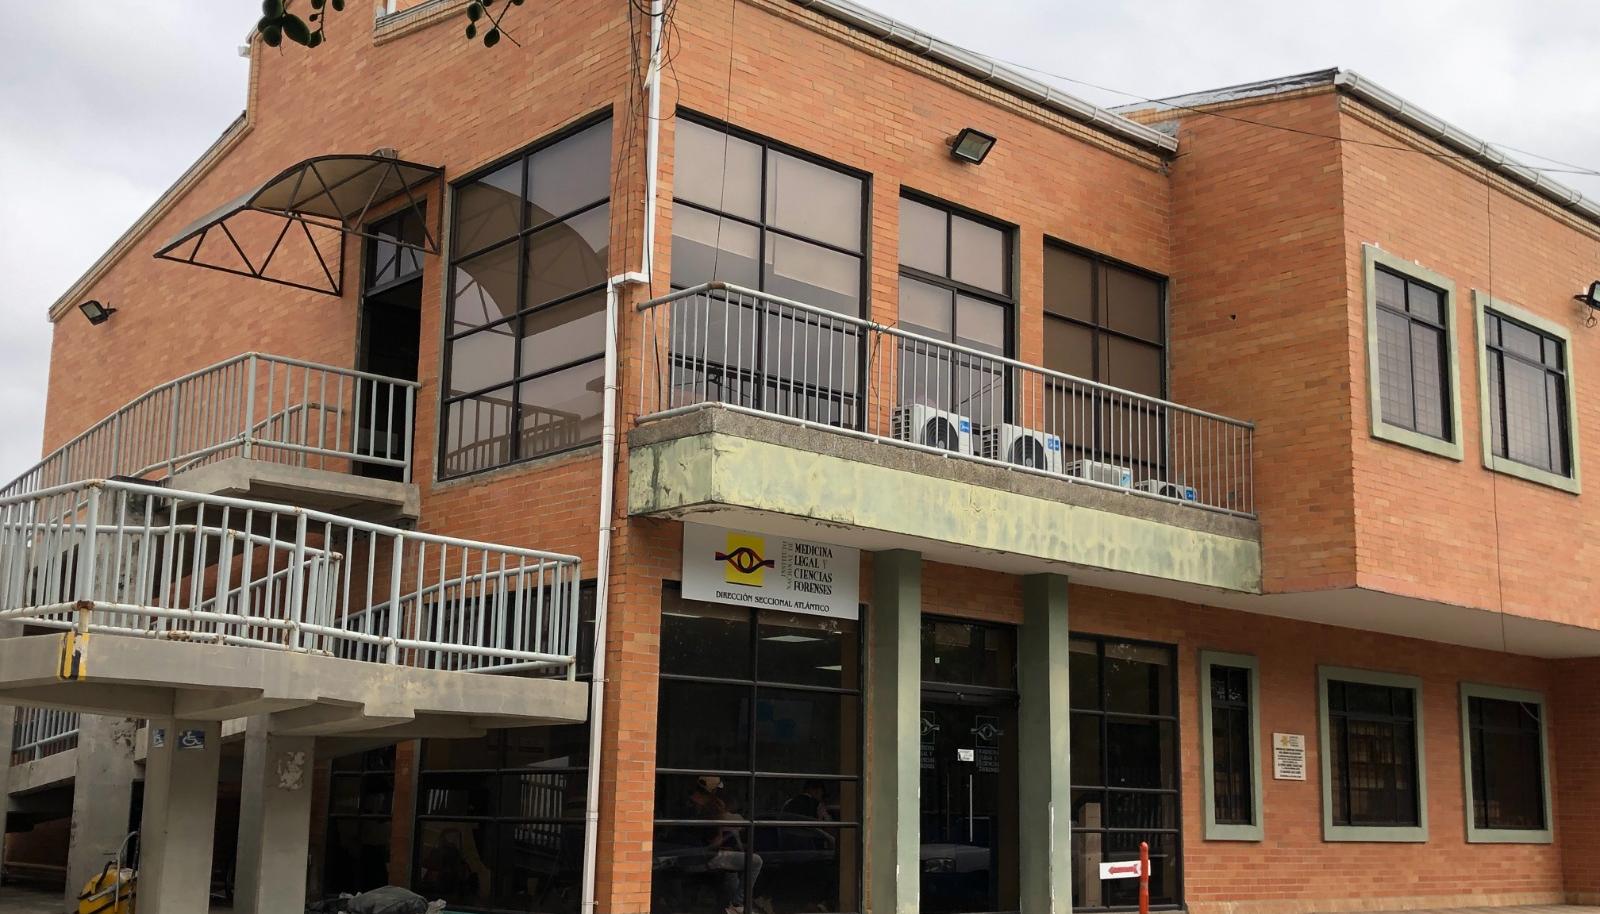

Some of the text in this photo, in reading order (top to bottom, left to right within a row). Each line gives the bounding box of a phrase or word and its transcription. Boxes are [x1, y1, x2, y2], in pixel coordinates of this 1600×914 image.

[794, 542, 832, 558] MEDICINA
[794, 555, 820, 568] LEGAL
[794, 568, 832, 582] CIENCIAS
[794, 580, 832, 595] FORENSES
[716, 590, 830, 612] DIRECCIÓN SECCIONAL ATLÁNTICO
